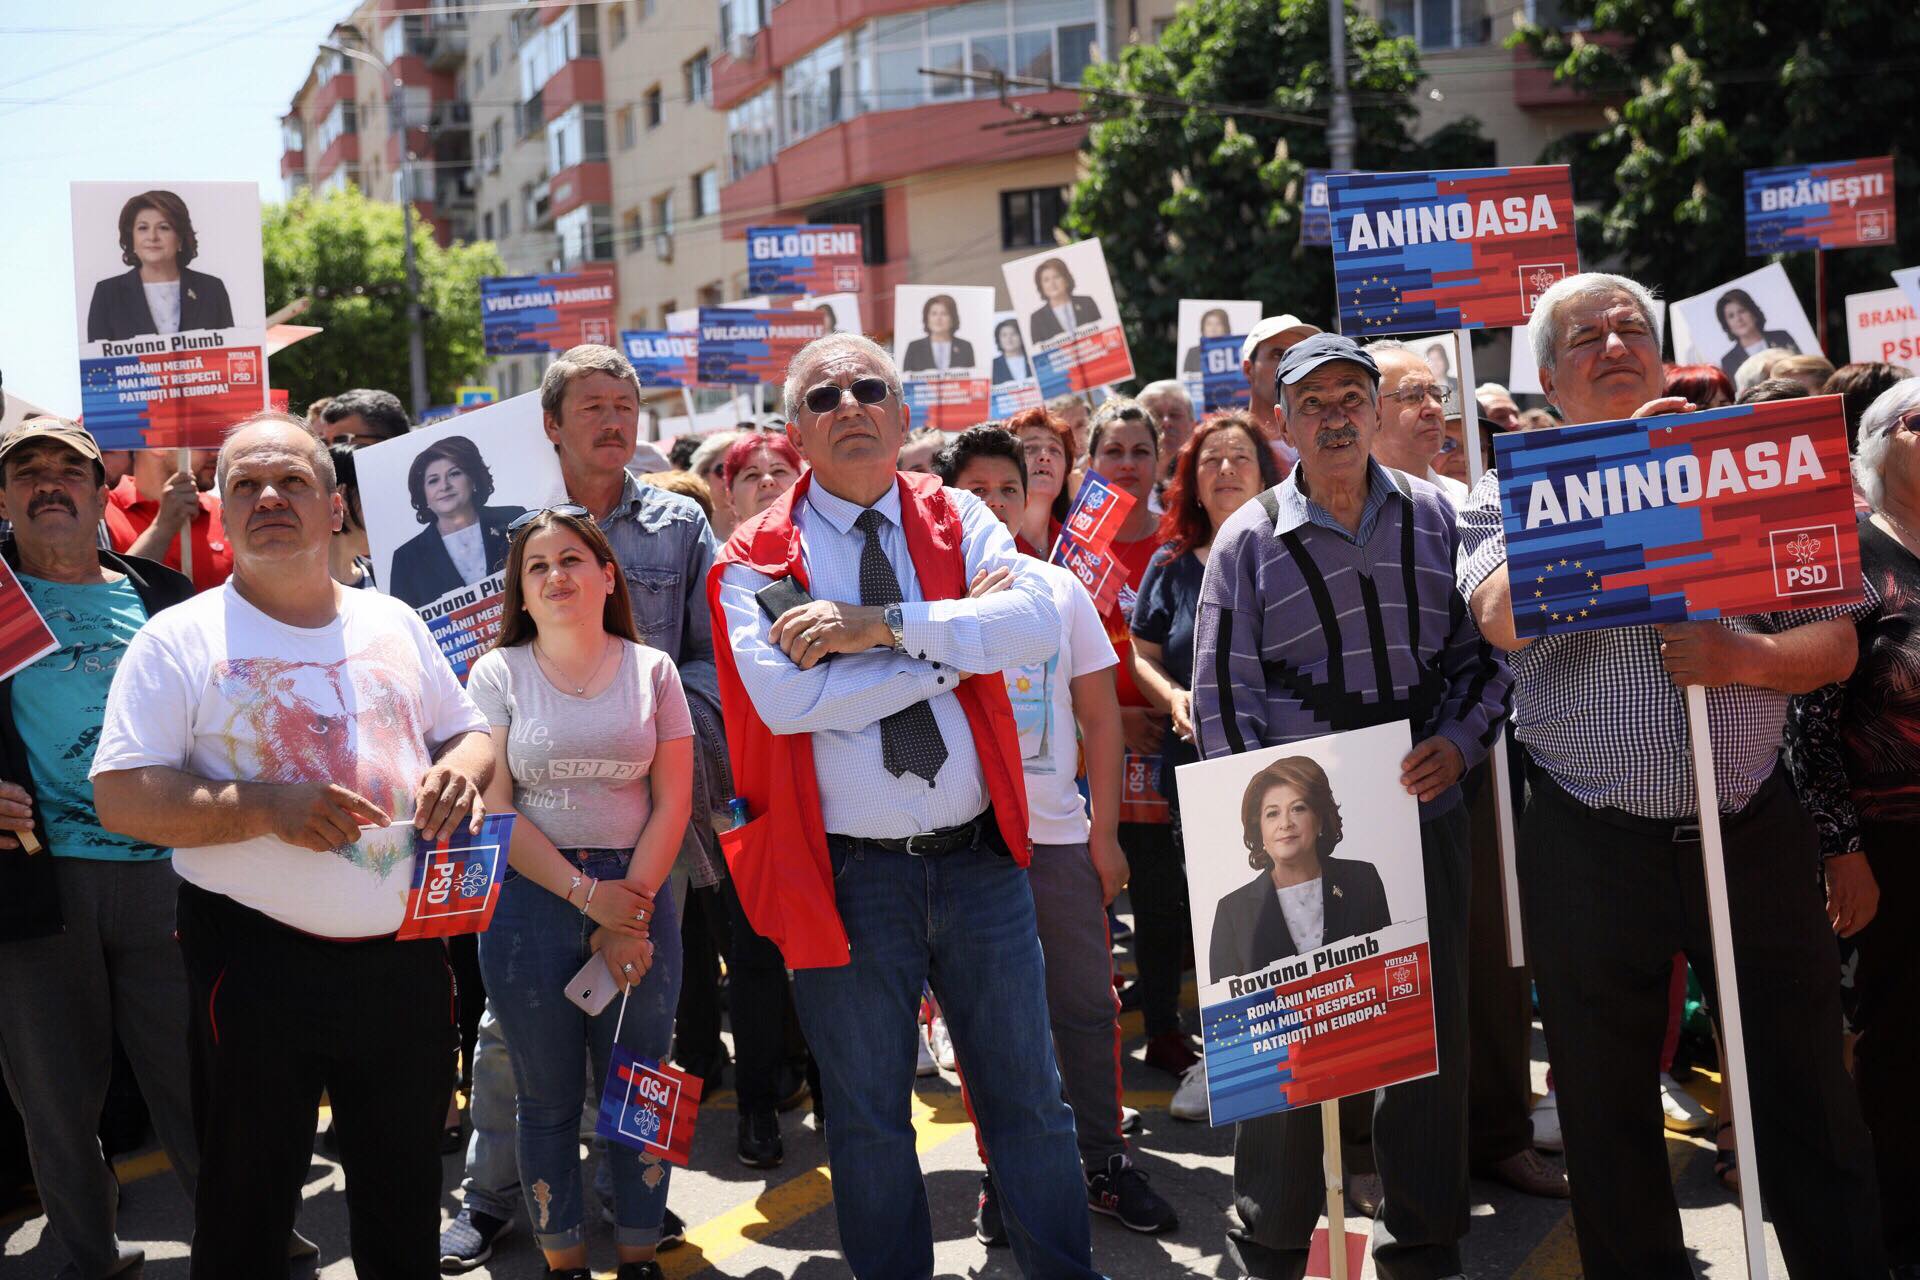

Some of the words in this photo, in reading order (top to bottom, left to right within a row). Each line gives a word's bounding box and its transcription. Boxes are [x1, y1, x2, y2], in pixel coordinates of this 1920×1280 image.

[1760, 173, 1884, 211] BRĂNEȘTI
[1348, 194, 1558, 252] ANINOASA
[753, 232, 856, 259] GLODENI
[487, 291, 553, 311] VULCANA
[555, 285, 612, 305] PANDELE
[102, 340, 166, 357] Rovana
[171, 332, 224, 352] Plumb
[703, 326, 767, 340] VULCANA
[768, 324, 823, 338] PANDELE
[628, 338, 697, 359] GLODE
[115, 360, 162, 376] ROMÂNII
[163, 356, 204, 372] MERITĂ
[233, 372, 251, 383] PSD
[117, 378, 139, 390] MAI
[140, 375, 169, 388] MULT
[171, 370, 221, 384] RESPECT!
[169, 388, 181, 399] IN
[183, 383, 229, 398] EUROPA!
[1525, 434, 1826, 530] ANINOASA
[1071, 554, 1094, 585] PSD
[1785, 564, 1828, 588] PSD
[480, 577, 506, 599] Plu
[431, 615, 476, 640] OMÂNII
[476, 603, 504, 621] MER
[441, 638, 454, 653] AI
[455, 629, 485, 650] MULT
[509, 718, 554, 751] Me,
[508, 753, 545, 785] My
[552, 761, 646, 779] SELFI
[1129, 762, 1145, 793] PSD
[520, 788, 557, 809] And
[560, 788, 577, 810] I.
[427, 863, 455, 904] PSD
[1229, 961, 1308, 999] Rovana
[1313, 936, 1379, 973] Plumb
[1384, 951, 1418, 967] VOTEAZĂ
[1247, 992, 1304, 1021] ROMÂNII
[1306, 973, 1355, 1002] MERITĂ
[1392, 983, 1413, 997] PSD
[1249, 1019, 1276, 1037] MAI
[1278, 1007, 1313, 1029] MULT
[1315, 987, 1377, 1017] RESPECT!
[1252, 1027, 1312, 1055] PATRIOȚI
[1314, 1020, 1329, 1036] IN
[1331, 1002, 1387, 1030] EUROPA!
[640, 1076, 670, 1106] PSD
